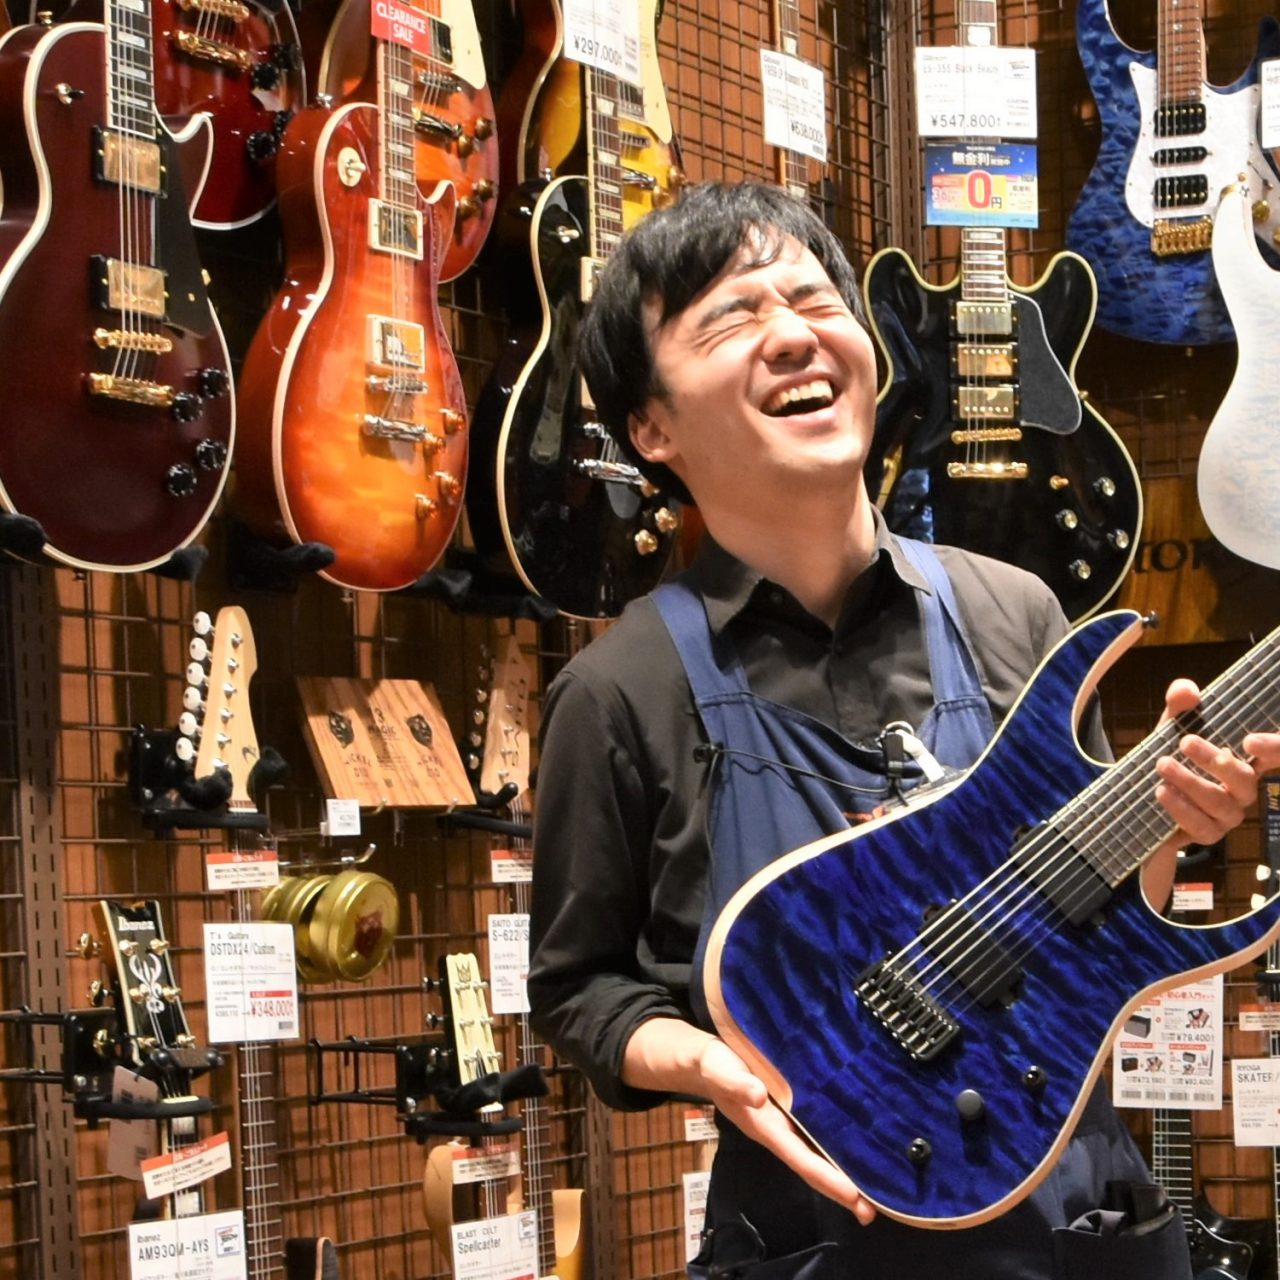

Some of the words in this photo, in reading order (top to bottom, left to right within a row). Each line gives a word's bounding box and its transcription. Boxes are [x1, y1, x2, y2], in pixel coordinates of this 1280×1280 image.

[376, 2, 426, 35] CLEARANCE
[393, 24, 415, 44] SALE
[514, 919, 530, 928] GUIT
[458, 1237, 501, 1255] Spellcaster
